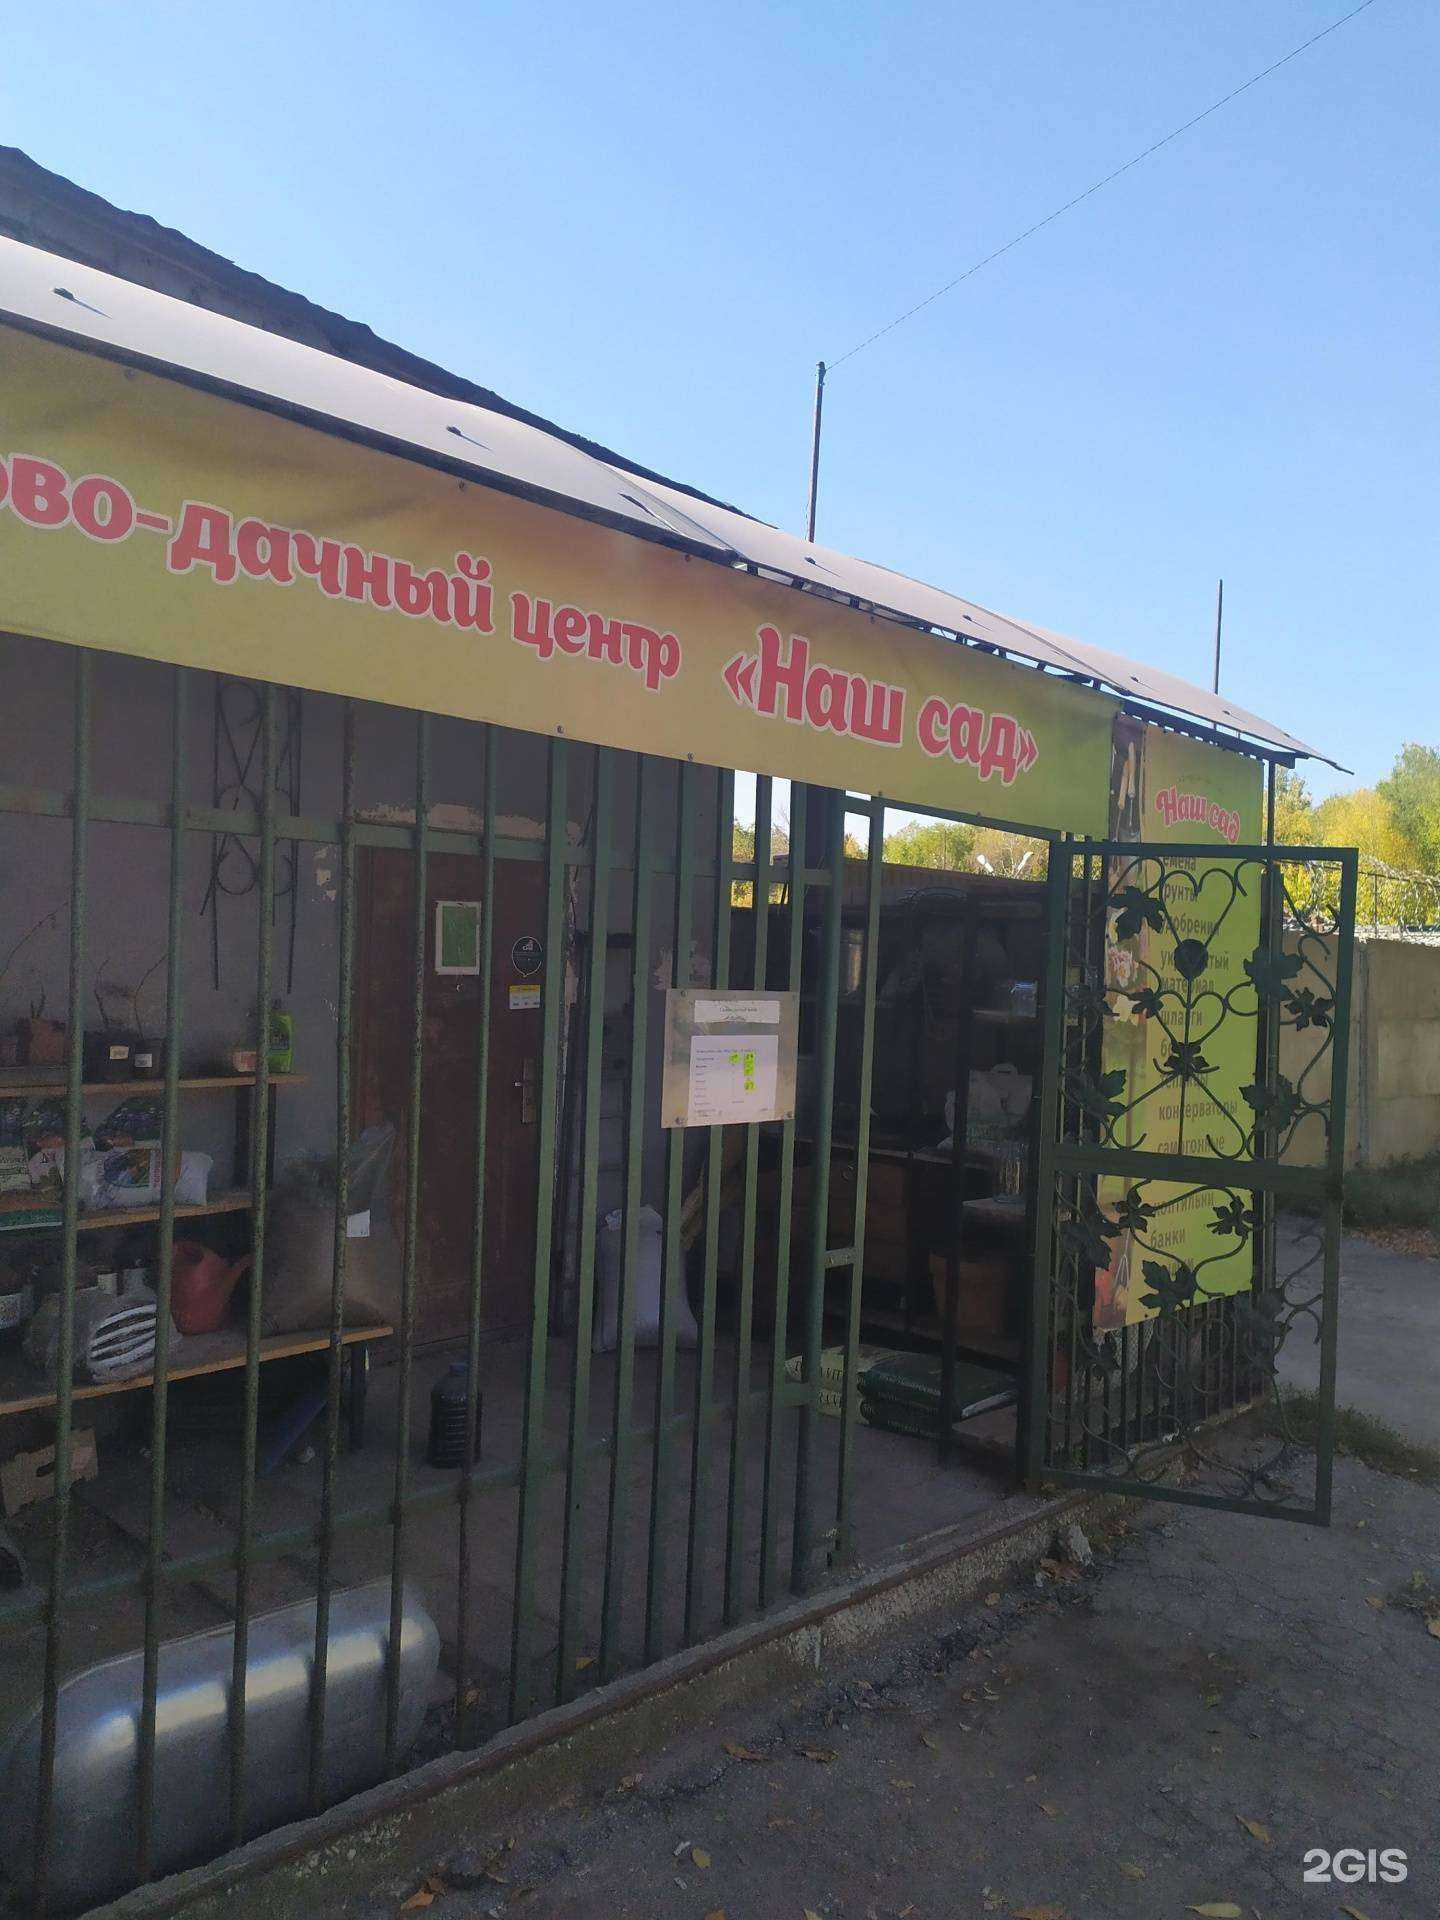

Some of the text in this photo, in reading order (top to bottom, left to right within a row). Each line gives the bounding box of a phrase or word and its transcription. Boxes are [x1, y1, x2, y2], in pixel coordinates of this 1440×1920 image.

[0, 454, 1039, 787] во-дачный центр «Наш сад»
[1154, 785, 1240, 843] Наш сад
[1160, 857, 1197, 872] емена
[1161, 884, 1199, 905] рунты
[1159, 1101, 1238, 1123] конерватры
[1151, 1228, 1185, 1248] банки
